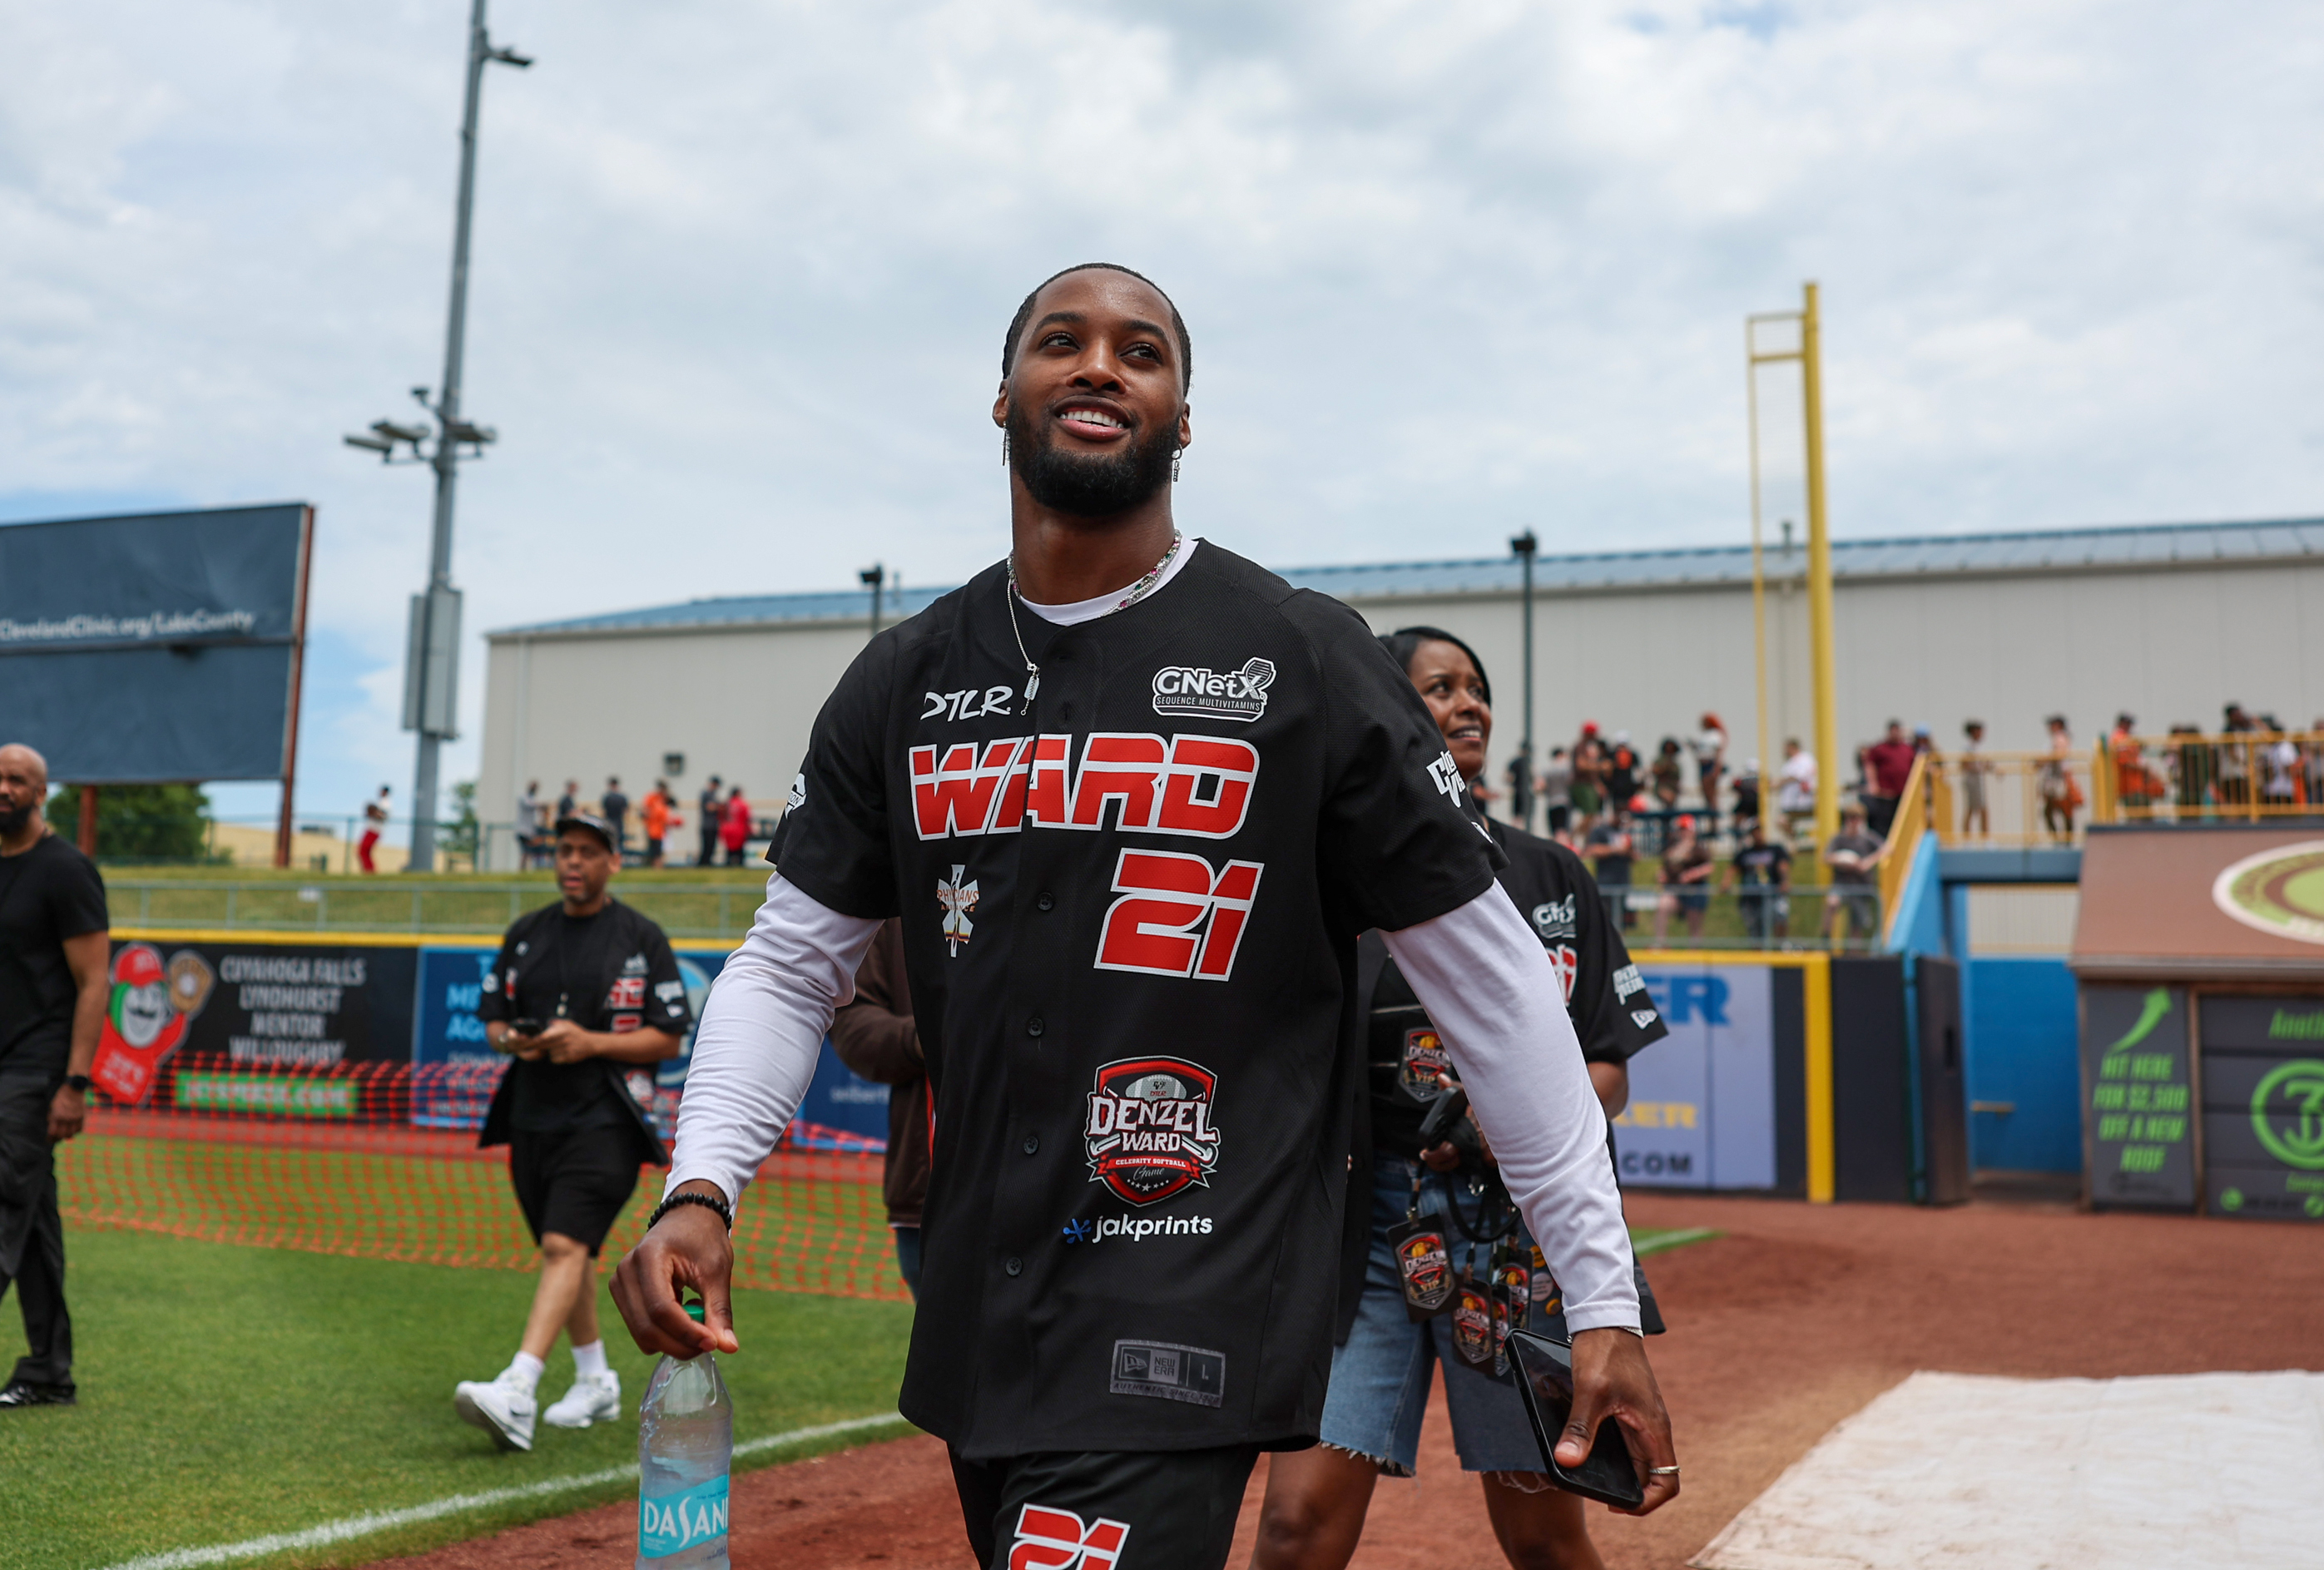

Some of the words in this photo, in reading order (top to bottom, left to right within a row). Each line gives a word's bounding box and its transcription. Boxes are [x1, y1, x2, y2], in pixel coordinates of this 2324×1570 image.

[1157, 669, 1262, 700] GNetX
[920, 686, 1012, 721] DTLR
[1156, 696, 1196, 706] SEQUENCE
[1198, 697, 1261, 711] MULTIVITAMINS
[909, 732, 1260, 841] WARD
[1093, 847, 1265, 982] 21
[220, 955, 311, 983] CUYAHOGA
[313, 958, 367, 987] FALLS
[238, 983, 344, 1014] LYNDHURST
[250, 1012, 326, 1038] MENTOR
[229, 1035, 347, 1068] WILLOUGHBY
[2130, 1052, 2173, 1082] HERE
[2093, 1082, 2127, 1111] FOR
[1088, 1096, 1217, 1142] DENZEL
[2098, 1113, 2129, 1142] OFF
[2128, 1113, 2144, 1142] A
[2144, 1113, 2187, 1143] NEW
[1122, 1132, 1182, 1152] WARD
[1115, 1157, 1152, 1166] CELEBRITY
[1152, 1157, 1187, 1168] SOFTBALL
[1132, 1165, 1165, 1181] Game
[1093, 1214, 1213, 1243] jakprints
[1153, 1366, 1175, 1377] ERA
[1154, 1356, 1176, 1367] NEW
[1114, 1382, 1165, 1394] AUTHENTIC
[1169, 1389, 1196, 1399] SINCE
[644, 1496, 728, 1548] DASANI
[1007, 1502, 1132, 1570] 21
